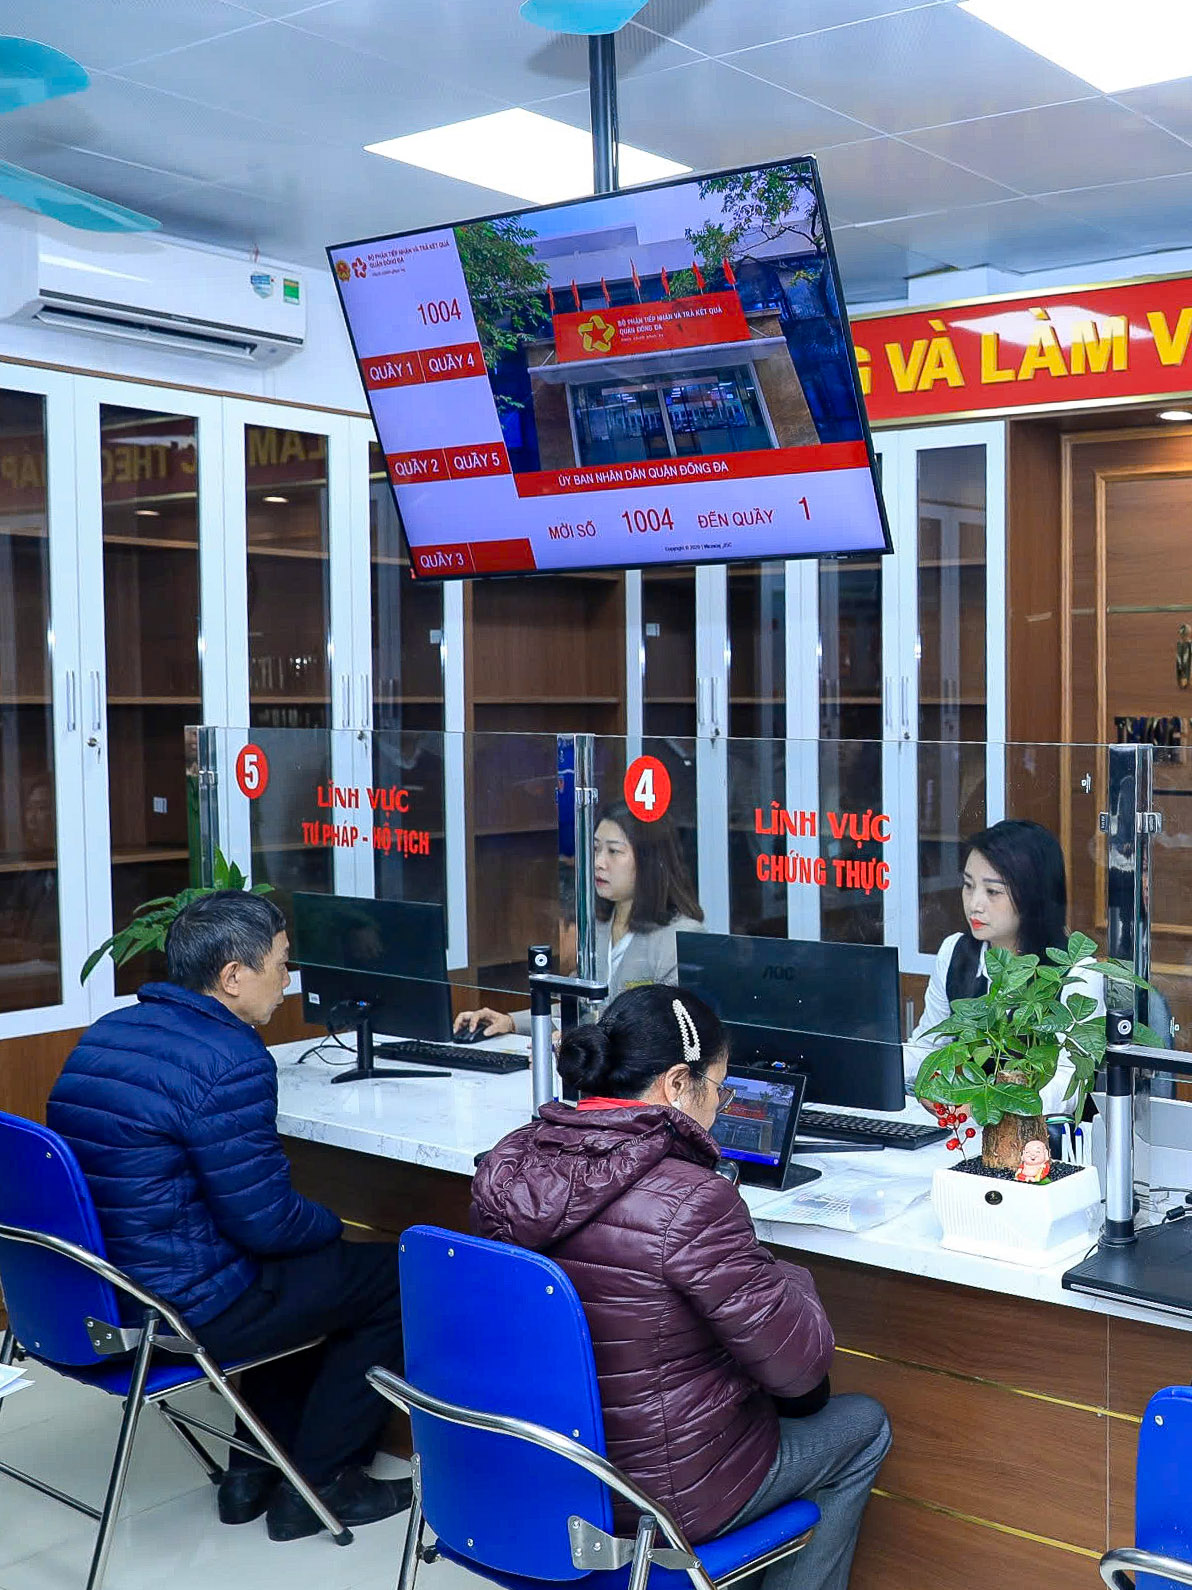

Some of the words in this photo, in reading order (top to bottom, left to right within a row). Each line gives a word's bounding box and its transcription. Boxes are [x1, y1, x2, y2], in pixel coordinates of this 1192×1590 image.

[417, 298, 461, 326] 1004
[428, 354, 464, 374] QUẦY
[466, 353, 475, 368] 4
[885, 319, 965, 393] VÀ
[980, 308, 1129, 385] LÀM
[369, 362, 403, 382] QUẦY
[405, 363, 414, 377] 1
[394, 458, 429, 477] QUẦY
[430, 458, 440, 474] 2
[453, 452, 489, 471] QUẦY
[491, 452, 500, 468] 5
[558, 472, 573, 488] ỦY
[574, 470, 594, 486] BAN
[596, 467, 624, 484] NHÂN
[625, 464, 646, 481] DÂN
[648, 463, 678, 481] QUẬN
[680, 461, 712, 477] ĐỐNG
[713, 460, 729, 475] ĐA
[548, 523, 575, 540] MỜI
[577, 519, 597, 537] SỐ
[621, 507, 674, 534] 1004
[698, 511, 729, 529] ĐẾN
[732, 508, 775, 527] QUẦY
[798, 496, 811, 521] 1
[420, 551, 454, 570] QUẦY
[455, 552, 465, 568] 3
[243, 753, 260, 791] 5
[634, 769, 656, 811] 4
[317, 776, 359, 809] LĨNH
[367, 785, 409, 818] VỰC
[301, 820, 321, 846] TƯ
[322, 821, 358, 848] PHÁP
[372, 822, 392, 856] HỘ
[394, 828, 430, 858] TỊCH
[754, 800, 817, 837] LĨNH
[826, 809, 891, 849] VỰC
[756, 849, 827, 887] CHỨNG
[832, 856, 891, 896] THỰC
